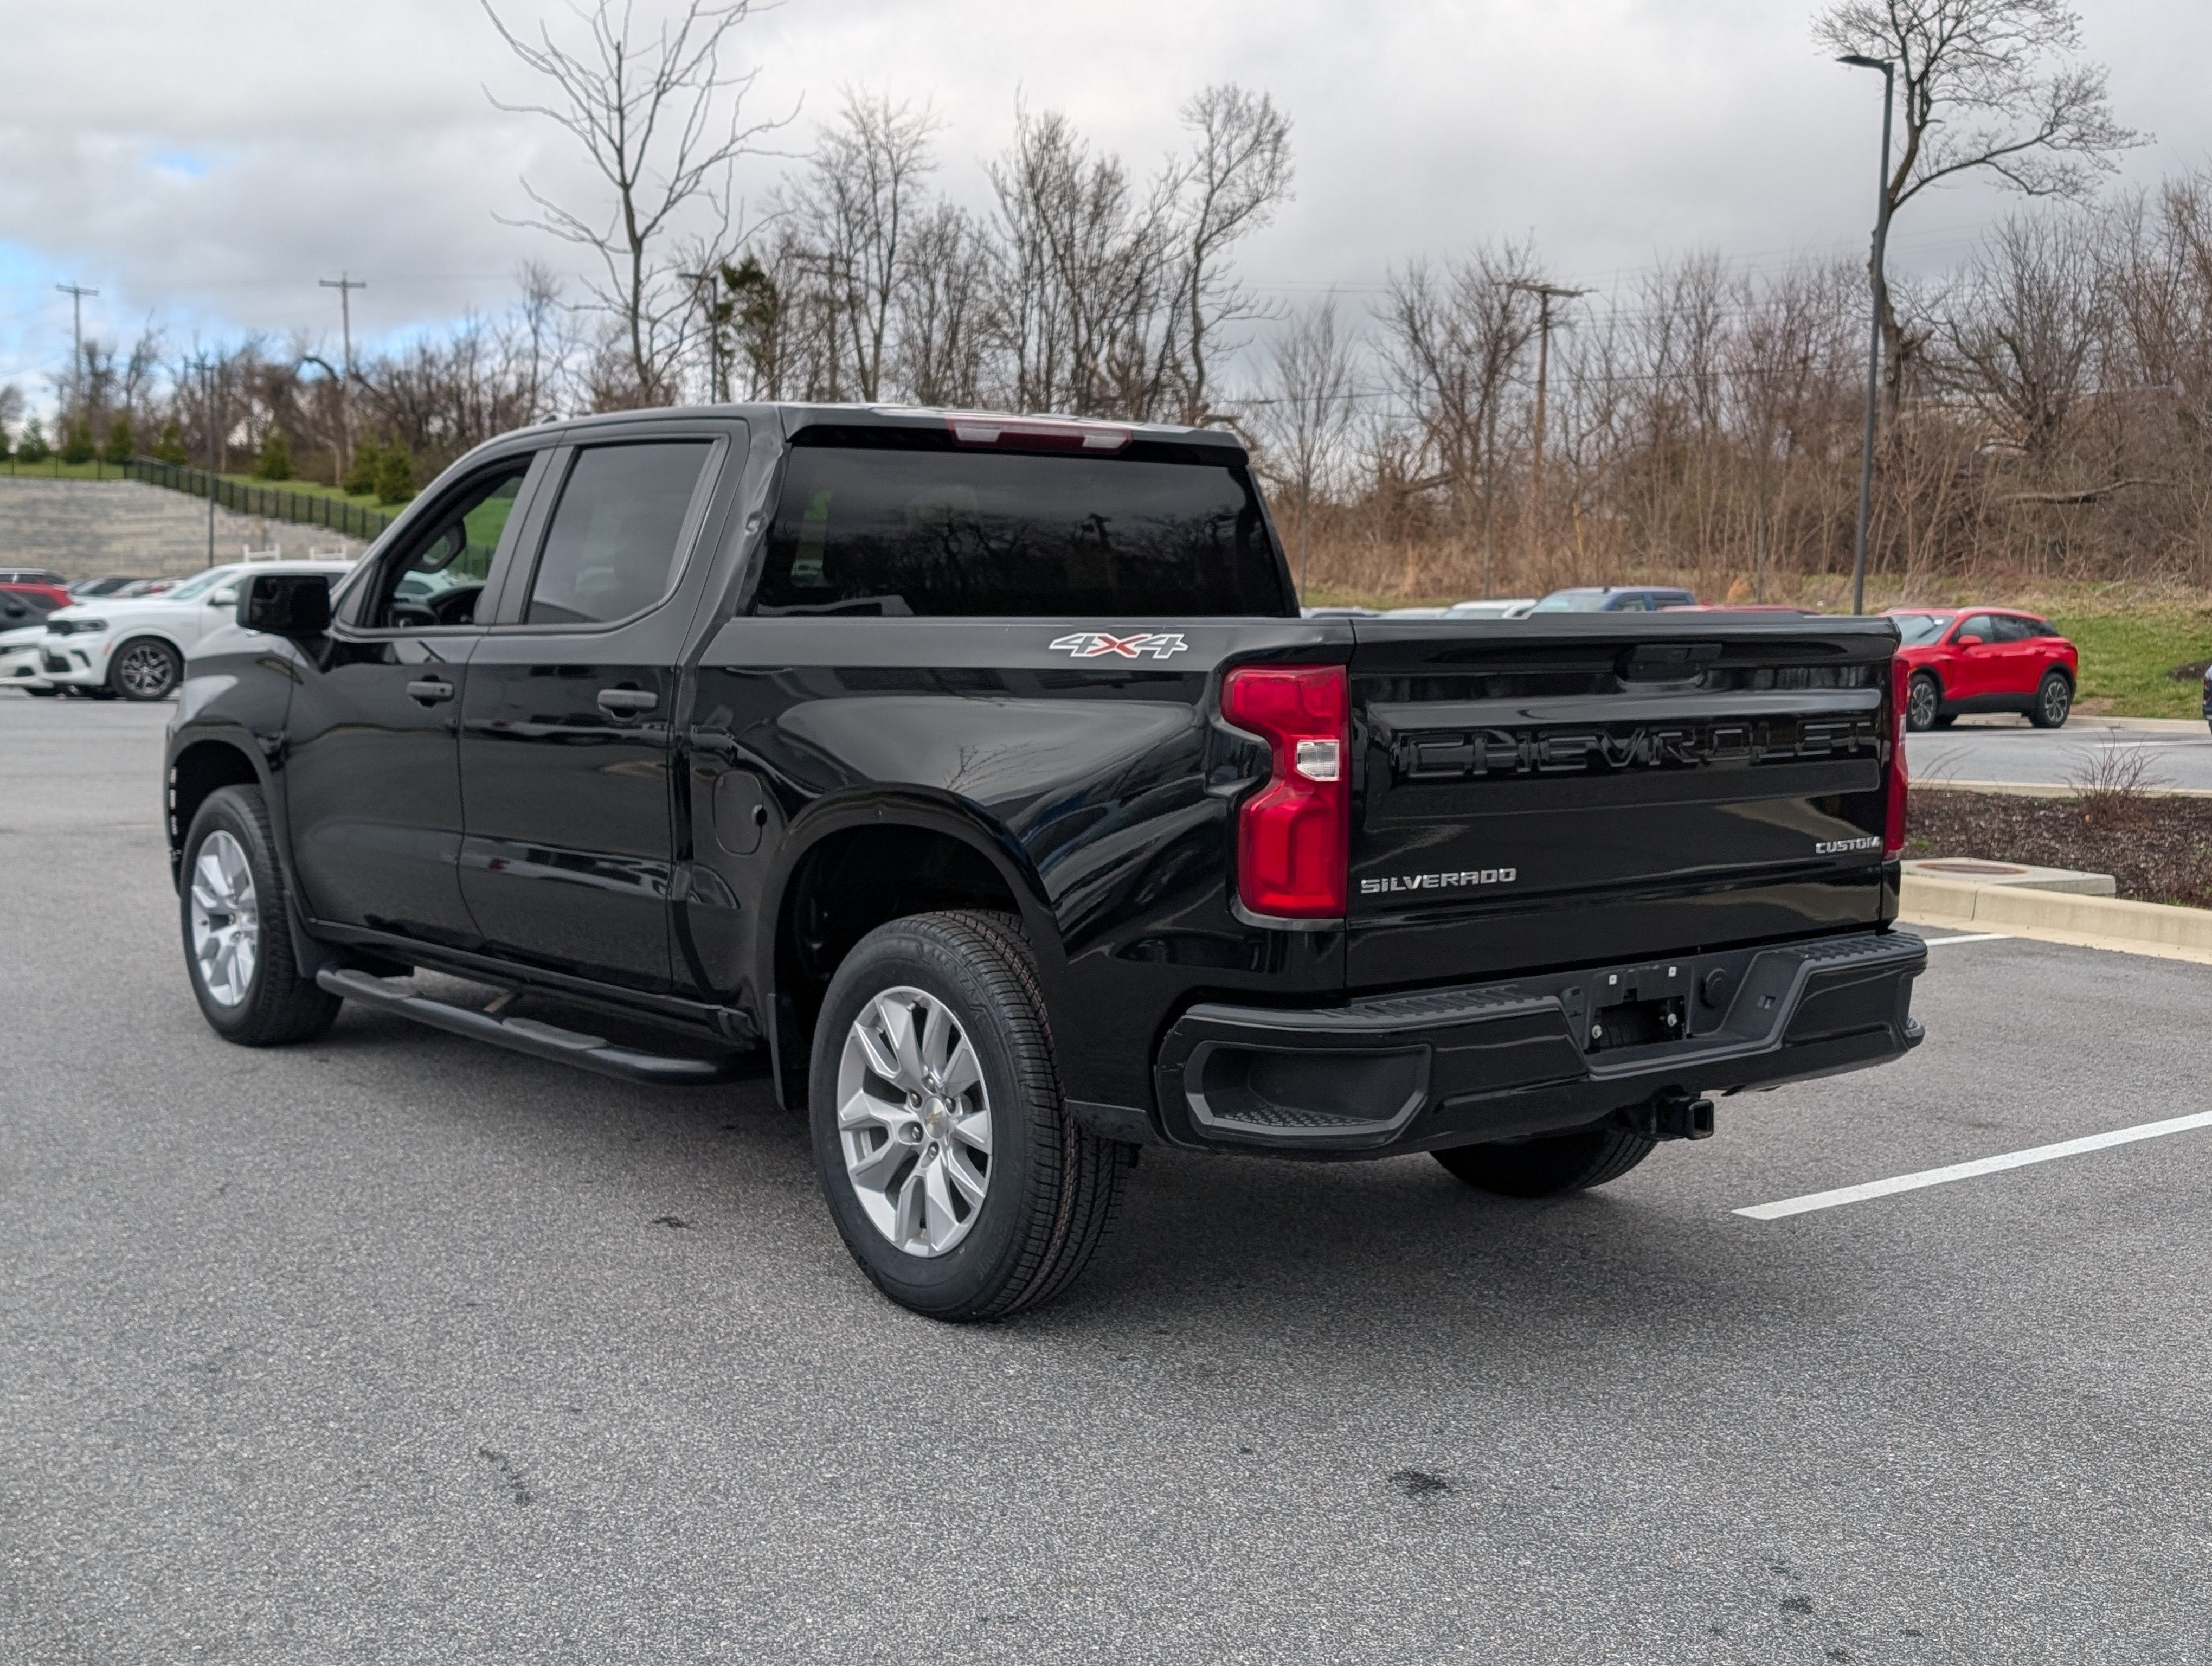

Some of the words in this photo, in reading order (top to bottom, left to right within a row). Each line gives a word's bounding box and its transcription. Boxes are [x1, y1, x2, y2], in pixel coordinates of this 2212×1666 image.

[1408, 717, 1870, 778] CHEVROLET
[1816, 836, 1880, 854] CUSTOM
[1361, 868, 1516, 894] SILVERADO
